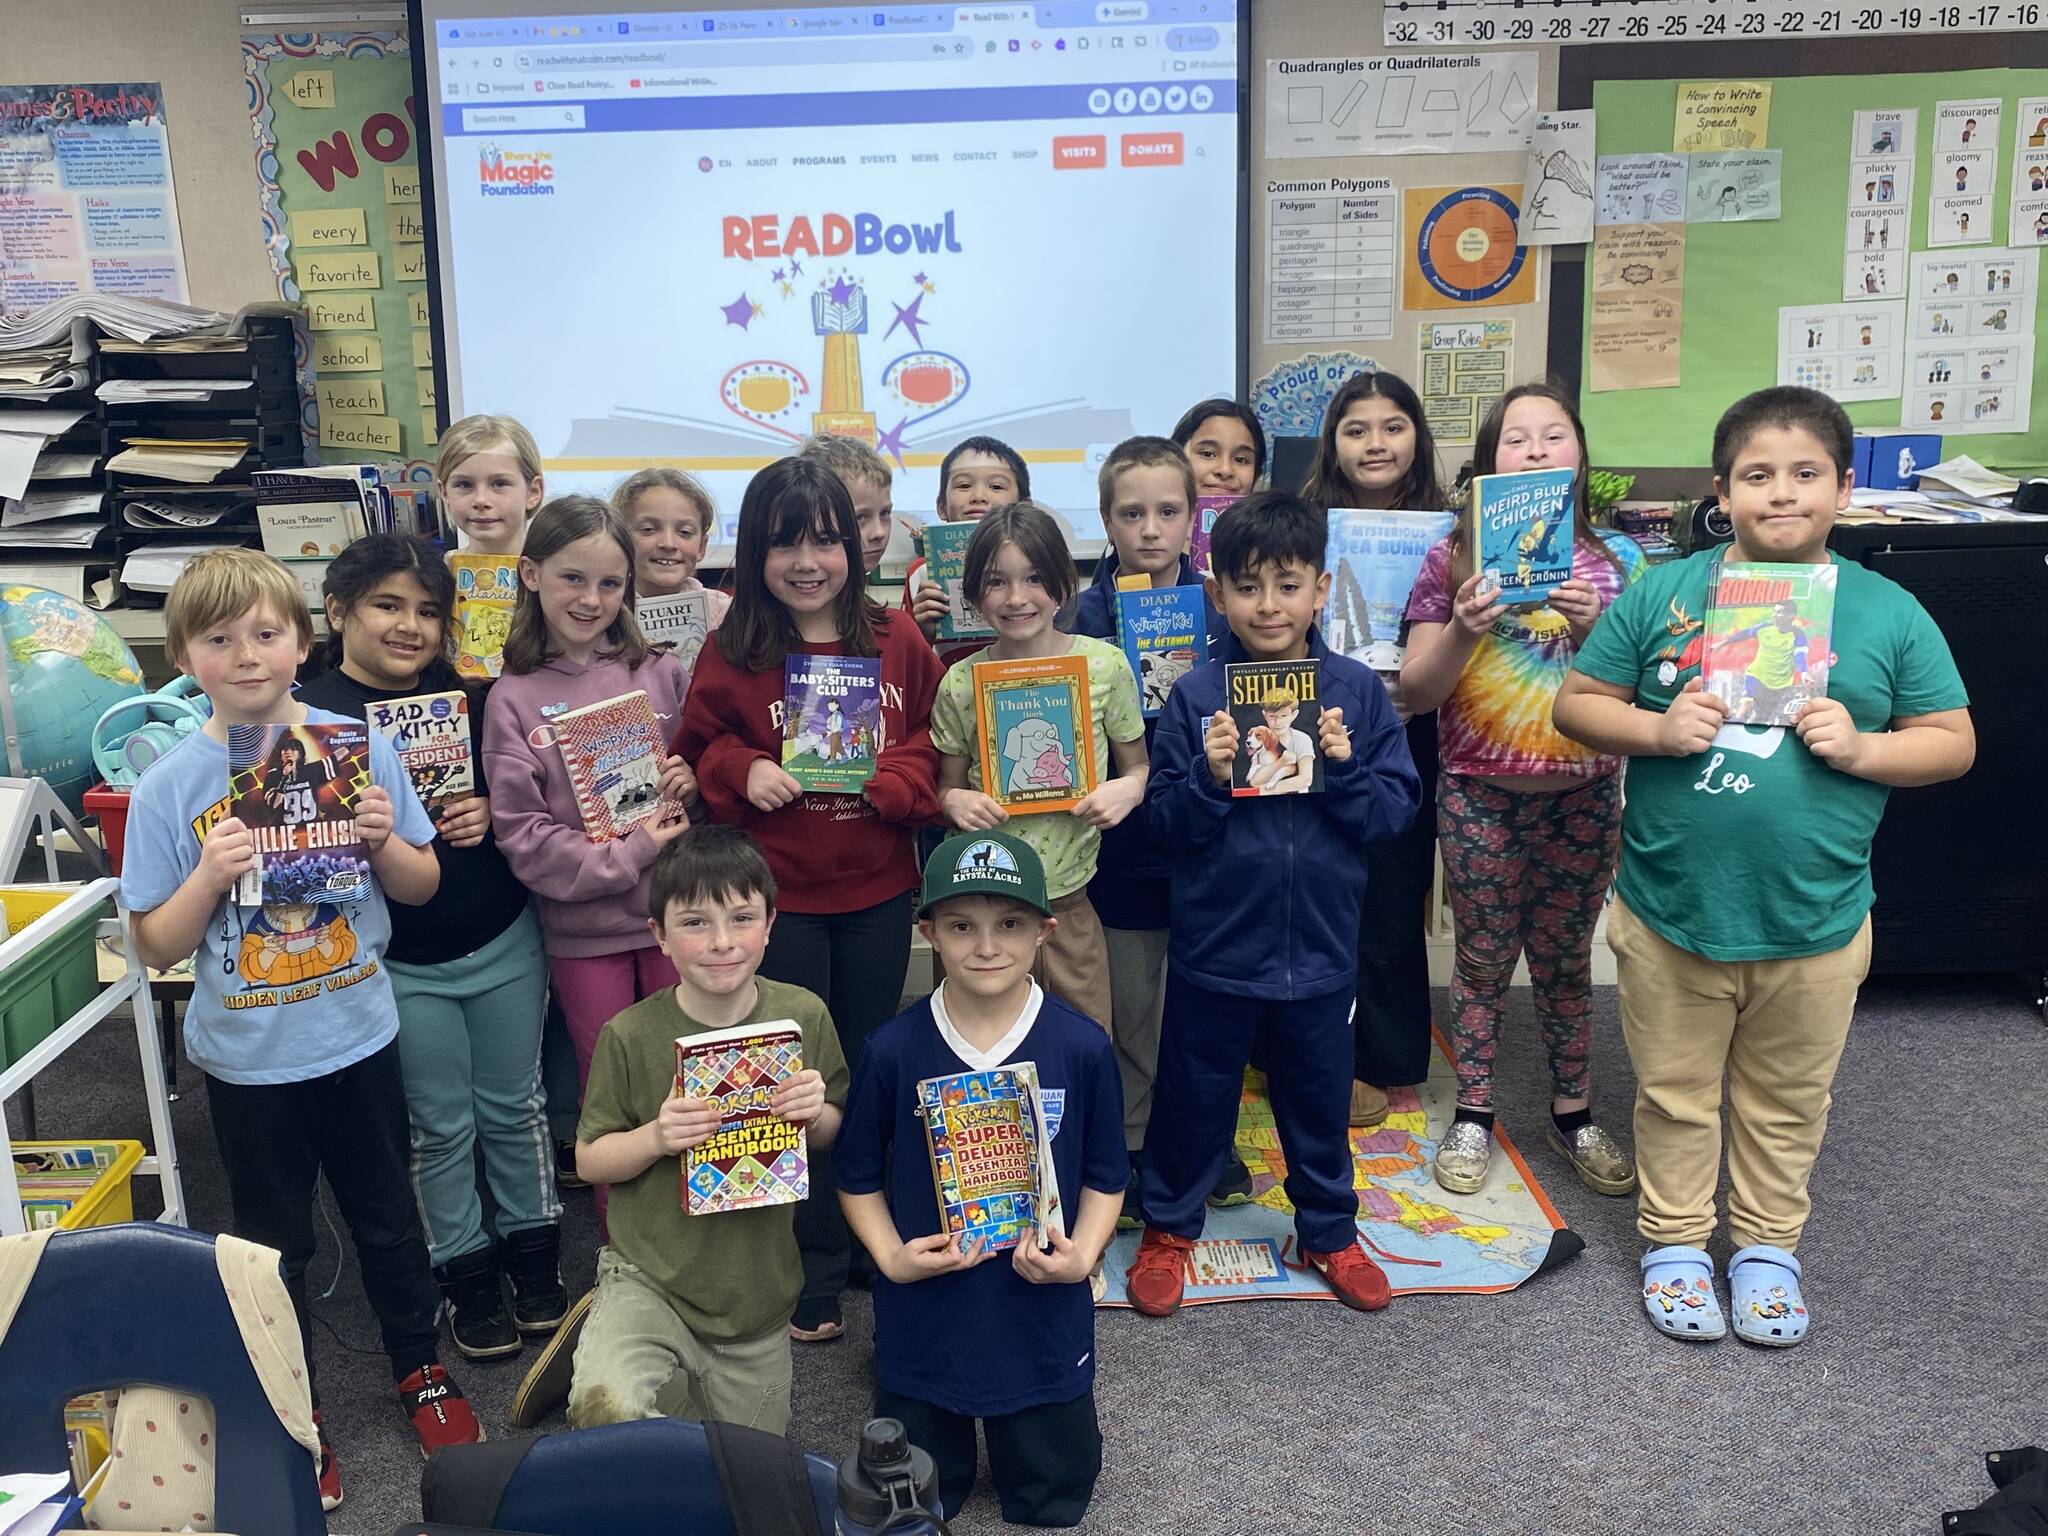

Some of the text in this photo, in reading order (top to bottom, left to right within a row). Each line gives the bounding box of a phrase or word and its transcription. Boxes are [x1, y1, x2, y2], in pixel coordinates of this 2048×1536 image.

[1113, 8, 1142, 17] Gemini
[1389, 4, 2038, 42] -32 -31 -30 -29 -28 -27 -26 -25 -24 -23 -22 -21 -20 -19 -18 -17 -16
[536, 52, 666, 66] readwithmalcolm.com/readbowl/
[1279, 55, 1482, 75] Quadrangles or Quadrilaterals
[291, 78, 324, 99] left
[1686, 89, 1762, 101] How to Write
[1686, 104, 1757, 117] a Convincing
[1875, 112, 1901, 122] brave
[1941, 106, 2000, 118] discouraged
[1561, 121, 1582, 130] Star.
[1697, 117, 1738, 130] Speech
[1061, 146, 1097, 159] VISITS
[1128, 143, 1175, 156] DONATE
[718, 149, 1038, 168] EN ABOUT PROGRAMS EVENTS NEWS CONTACT SHOP
[1698, 159, 1745, 169] State your
[1946, 153, 1982, 165] gloomy
[480, 158, 554, 185] Magic
[1634, 170, 1671, 179] could be
[1865, 163, 1897, 174] plucky
[480, 182, 555, 197] Foundation
[1267, 178, 1390, 193] Common Polygons
[1279, 199, 1379, 211] Polygon Number
[1944, 197, 1983, 208] doomed
[1342, 210, 1379, 220] of Sides
[1850, 206, 1905, 219] courageous
[312, 225, 357, 243] every
[1279, 228, 1310, 238] triangle
[1610, 229, 1667, 240] Support your
[1279, 241, 1325, 253] quadrangle
[1598, 239, 1641, 250] claim with
[1278, 255, 1318, 267] pentagon
[1864, 253, 1885, 262] bold
[1984, 259, 2016, 268] generous
[308, 264, 374, 283] favorite
[1277, 284, 1317, 295] heptagon
[1277, 299, 1311, 308] octagon
[315, 305, 366, 323] friend
[1277, 312, 1313, 323] nonagon
[1277, 326, 1312, 337] decagon
[322, 346, 369, 366] school
[1268, 365, 1346, 400] Proud of
[327, 389, 378, 409] teach
[328, 423, 393, 445] teacher
[1483, 482, 1570, 519] WEIRD BLUE
[268, 515, 337, 526] Louis Pasteur
[1491, 497, 1564, 531] CHICKEN
[1351, 526, 1427, 539] MYSTERIOUS
[1337, 538, 1373, 554] SEA
[467, 590, 517, 600] diaries
[1140, 593, 1181, 608] DIARY
[640, 604, 693, 621] STUART
[1151, 607, 1162, 618] of
[644, 615, 692, 632] LITTLE
[1128, 612, 1194, 635] Wimpy Kid
[1136, 634, 1196, 650] THE GETAWAY
[826, 668, 841, 676] THE
[790, 673, 876, 688] BABY-SITTERS
[816, 685, 849, 696] CLUB
[1024, 689, 1040, 698] The
[1233, 671, 1316, 706] SHILOH
[997, 696, 1068, 712] Thank You
[373, 703, 424, 728] BAD
[588, 708, 629, 729] DIARY
[1023, 710, 1045, 718] Book
[399, 715, 461, 741] KITTY
[432, 734, 450, 744] FOR
[582, 722, 647, 754] Wimpy Kid
[592, 740, 652, 774] Hot Mess
[1694, 752, 1756, 794] Leo
[1035, 789, 1065, 798] Willems
[797, 796, 861, 811] New York
[329, 874, 359, 888] TORQUE
[743, 1117, 767, 1130] EXTRA
[954, 1123, 1022, 1147] SUPER
[694, 1134, 800, 1165] HANDBOOK
[958, 1142, 1025, 1163] DELUXE
[961, 1159, 1028, 1175] ESSENTIAL
[963, 1169, 1030, 1188] HANDBOOK
[417, 1384, 448, 1403] FILA
